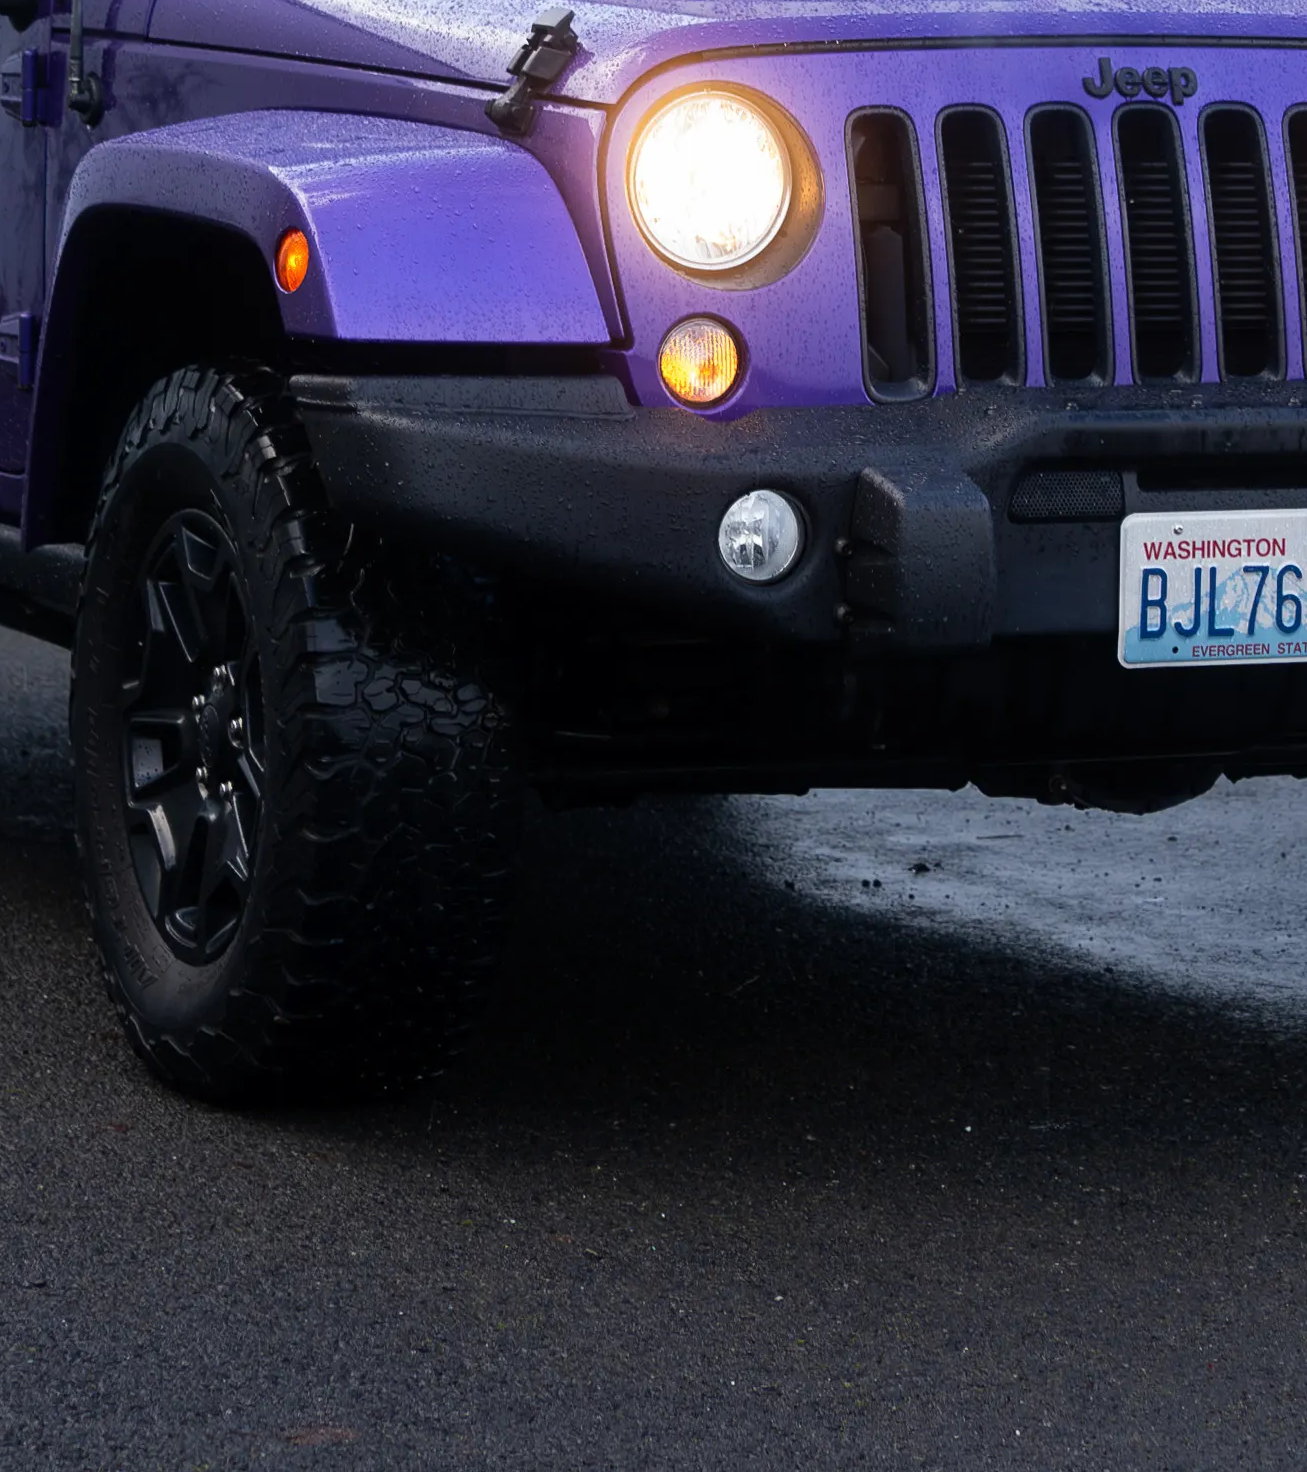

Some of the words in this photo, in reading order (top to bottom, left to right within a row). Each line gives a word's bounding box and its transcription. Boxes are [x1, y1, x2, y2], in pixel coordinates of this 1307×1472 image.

[1082, 57, 1198, 106] Jeep
[1143, 537, 1287, 561] WASHINGTON
[1191, 643, 1270, 658] EVERGREEN
